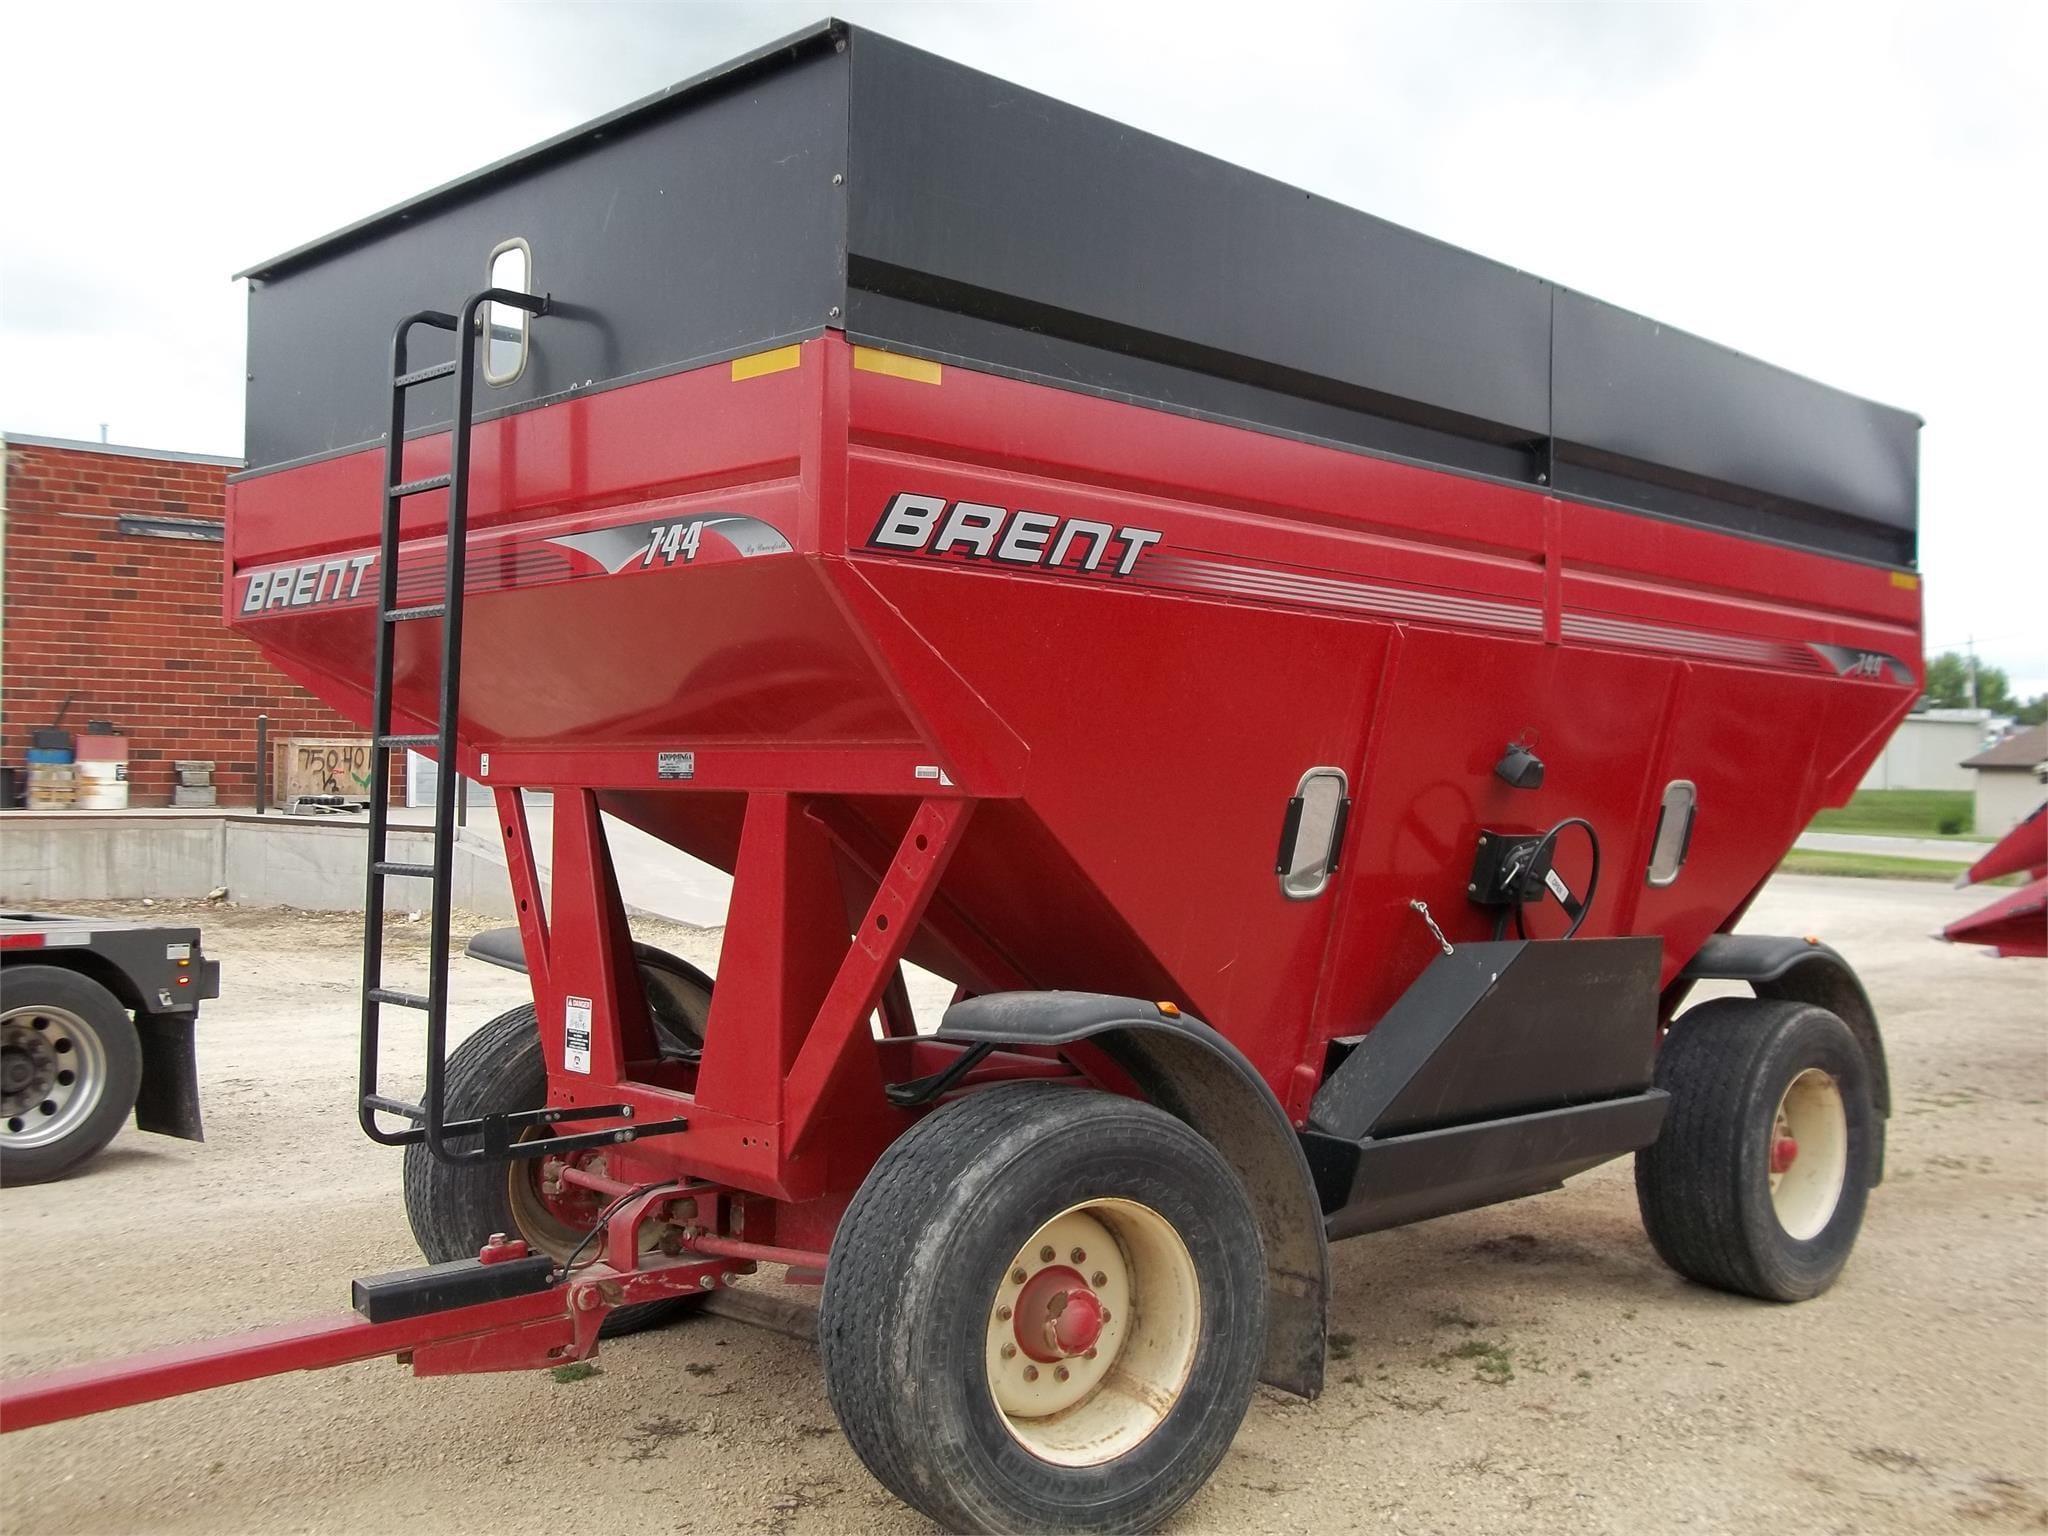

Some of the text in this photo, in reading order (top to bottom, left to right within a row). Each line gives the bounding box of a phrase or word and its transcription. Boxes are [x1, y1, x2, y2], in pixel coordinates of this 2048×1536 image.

[643, 520, 704, 566] 744
[871, 492, 1163, 576] BRENT
[241, 555, 377, 614] BRENT
